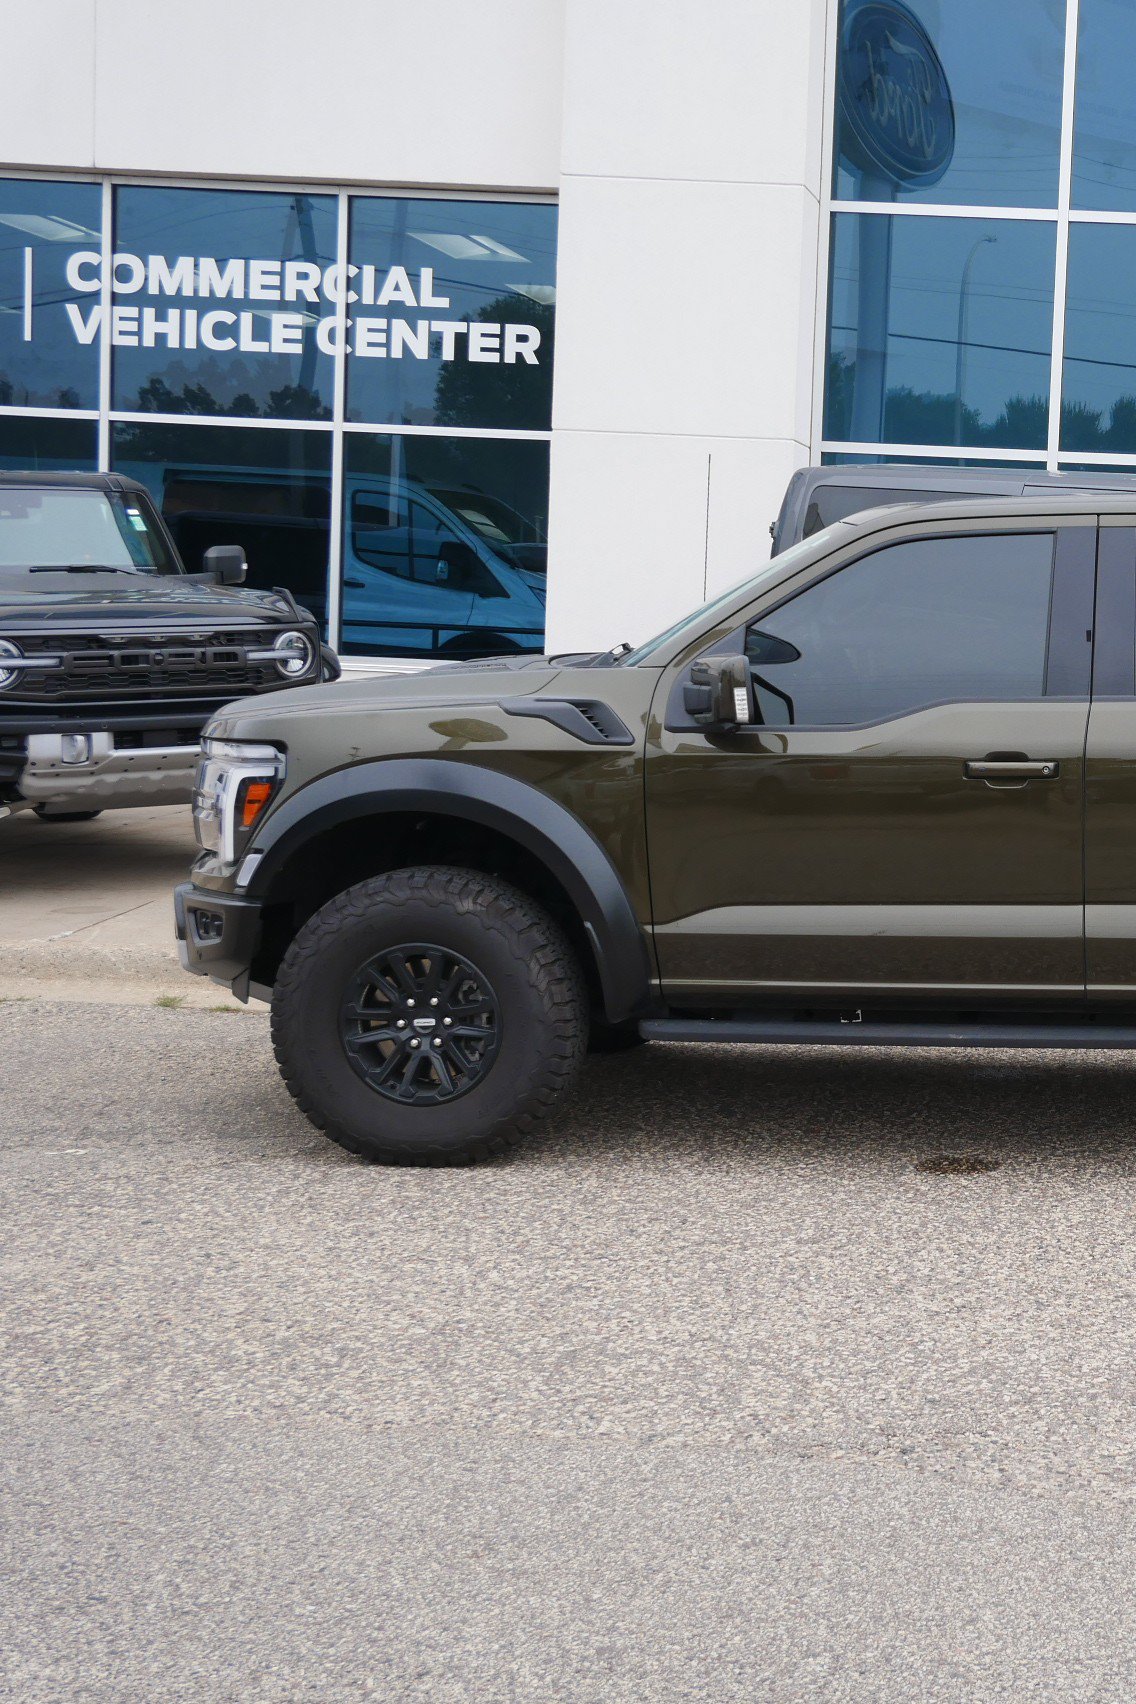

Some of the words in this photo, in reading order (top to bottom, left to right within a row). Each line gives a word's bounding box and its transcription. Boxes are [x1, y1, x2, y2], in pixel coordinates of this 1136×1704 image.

[66, 251, 450, 308] COMMERCIAL
[65, 303, 302, 355] VEHICLE
[316, 315, 541, 365] CENTER
[65, 648, 247, 674] FORD
